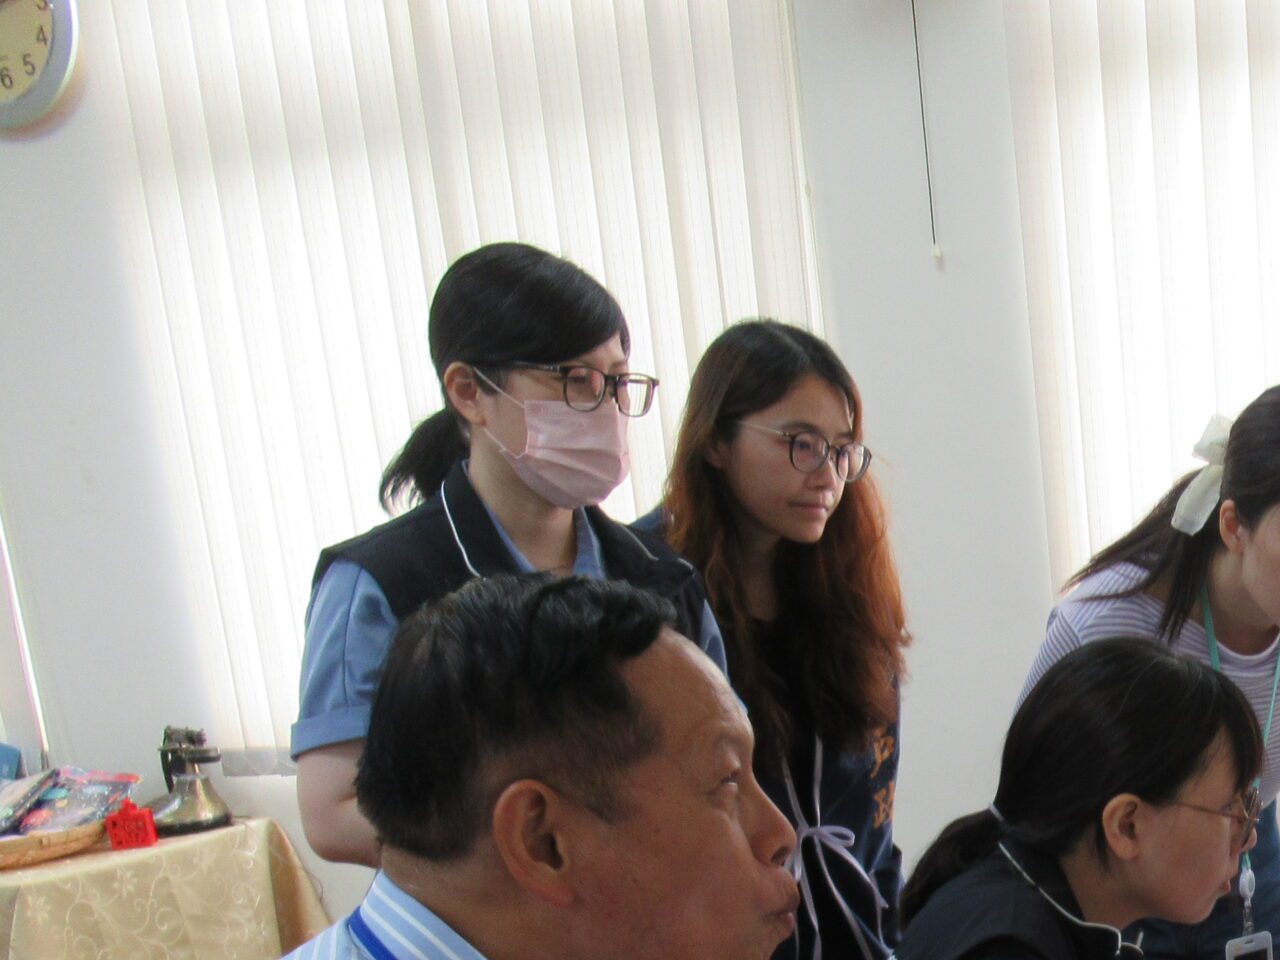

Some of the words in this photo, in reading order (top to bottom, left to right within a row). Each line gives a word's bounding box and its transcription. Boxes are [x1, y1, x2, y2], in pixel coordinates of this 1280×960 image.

[36, 25, 47, 46] 4
[23, 53, 36, 76] 5
[0, 66, 13, 89] 6
